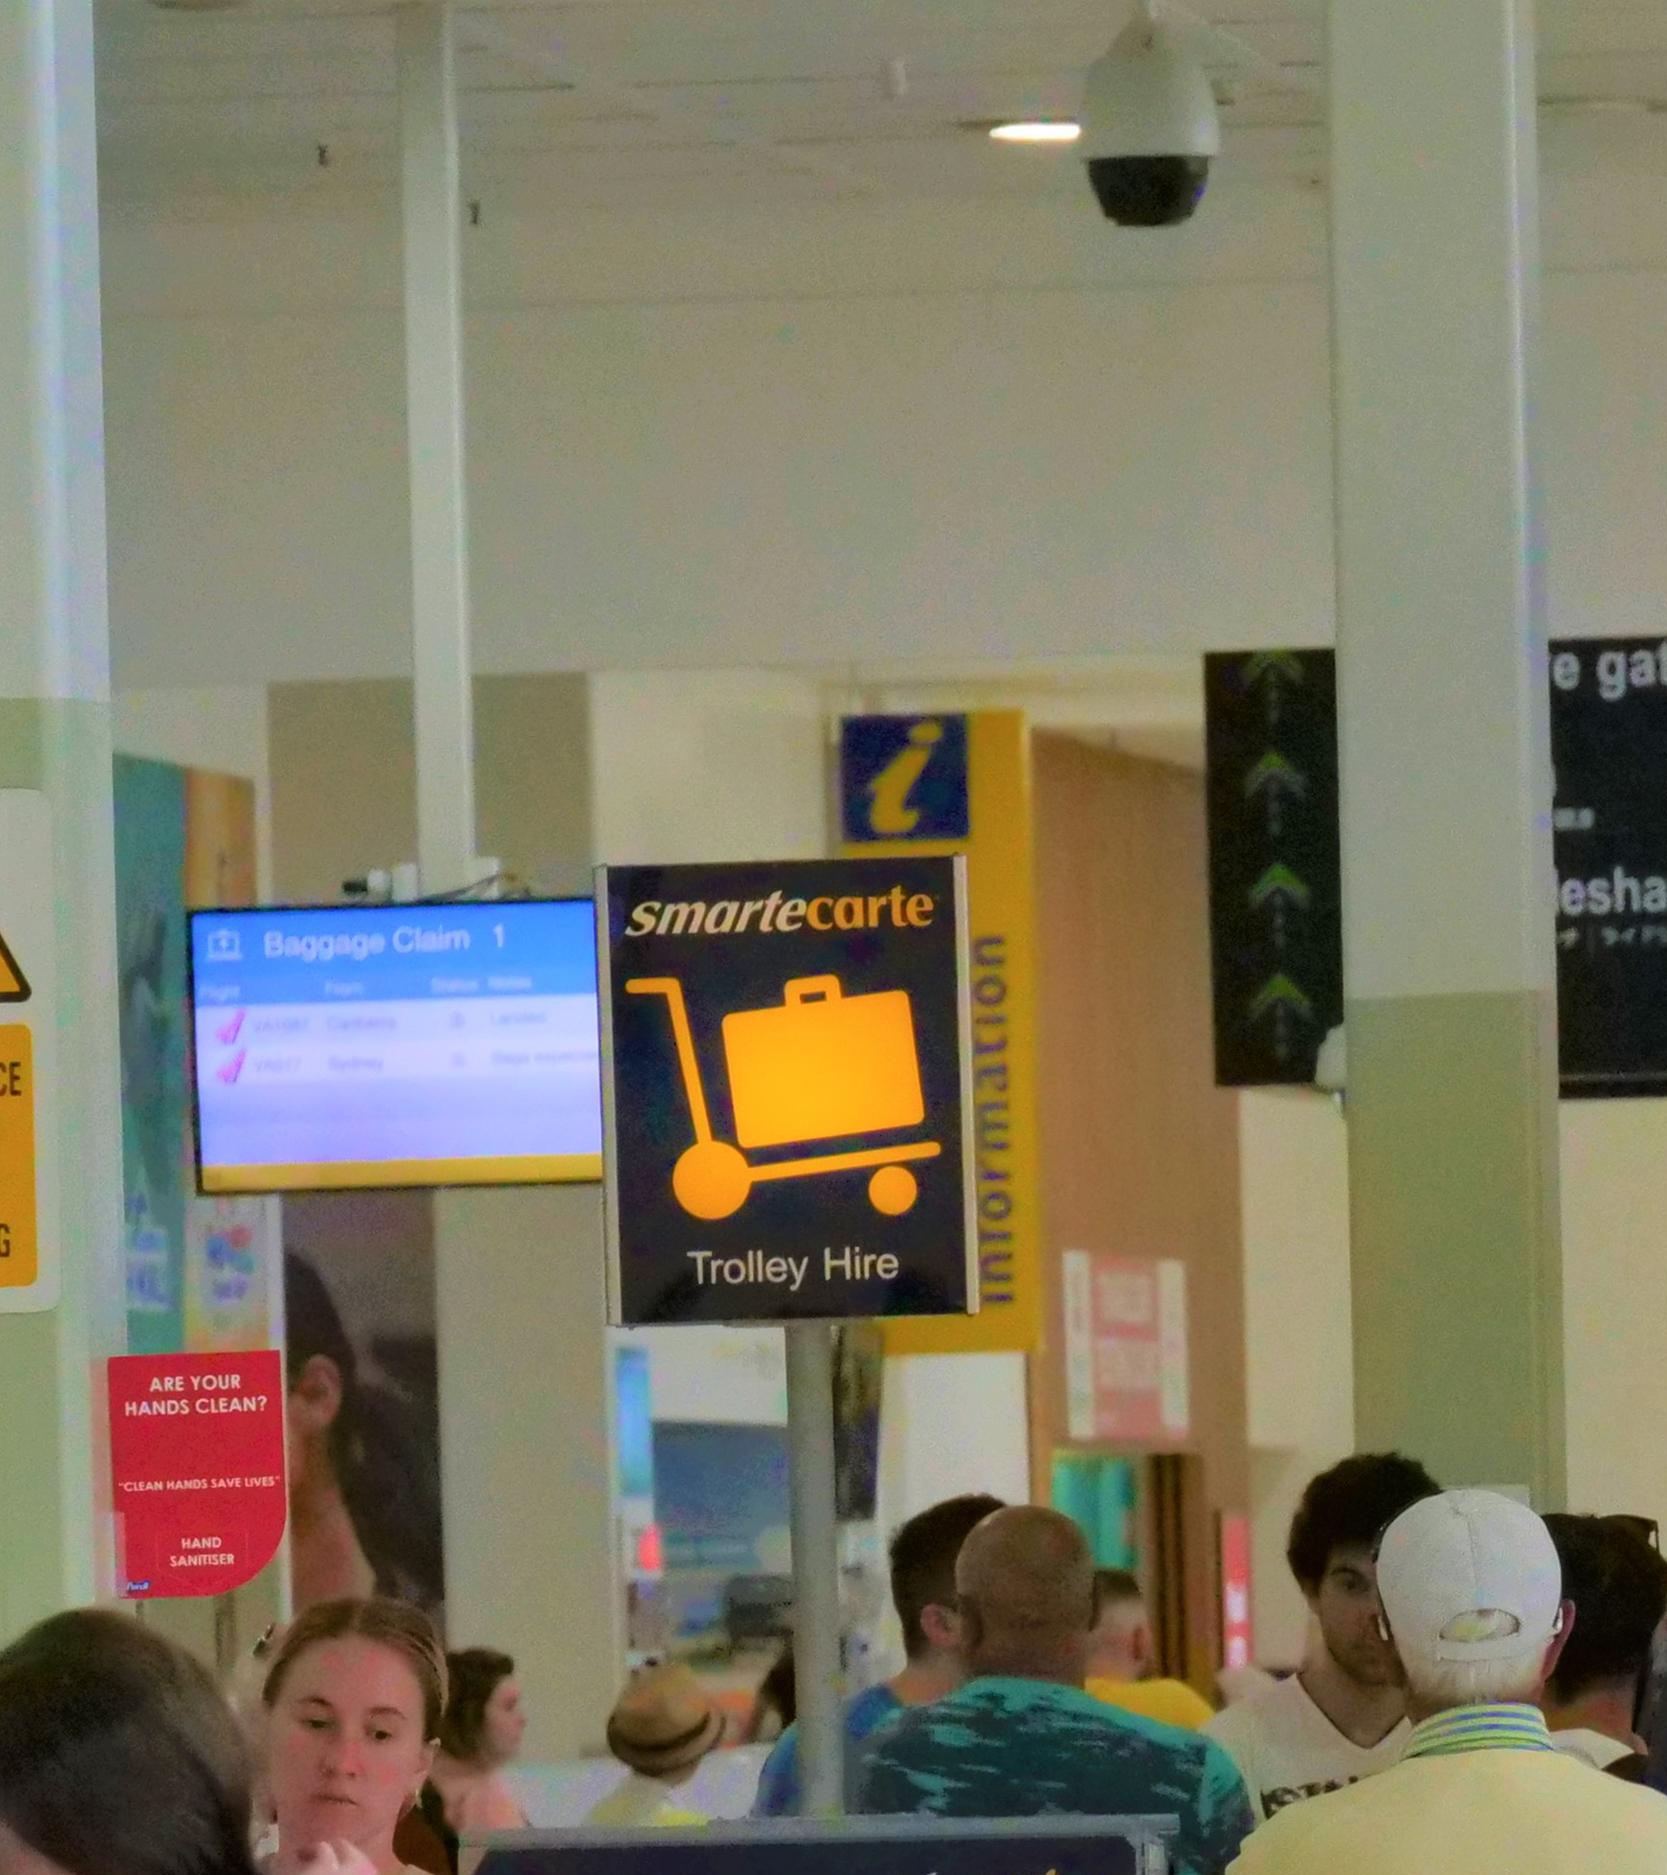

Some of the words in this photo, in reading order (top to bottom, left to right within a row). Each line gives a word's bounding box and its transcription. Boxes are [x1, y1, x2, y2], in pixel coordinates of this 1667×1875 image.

[625, 885, 935, 938] smartecarte
[263, 930, 387, 962] Baggage
[392, 924, 472, 954] Claim
[493, 923, 506, 951] 1
[686, 1250, 809, 1292] Trolley
[824, 1245, 899, 1281] Hire
[149, 1375, 185, 1393] ARE
[190, 1373, 242, 1391] YOUR
[124, 1398, 190, 1417] HANDS
[195, 1395, 269, 1415] CLEAN?
[166, 1478, 208, 1491] HANDS
[210, 1477, 242, 1490] SAVE
[180, 1536, 222, 1550] HAND
[169, 1553, 235, 1568] SANITISER
